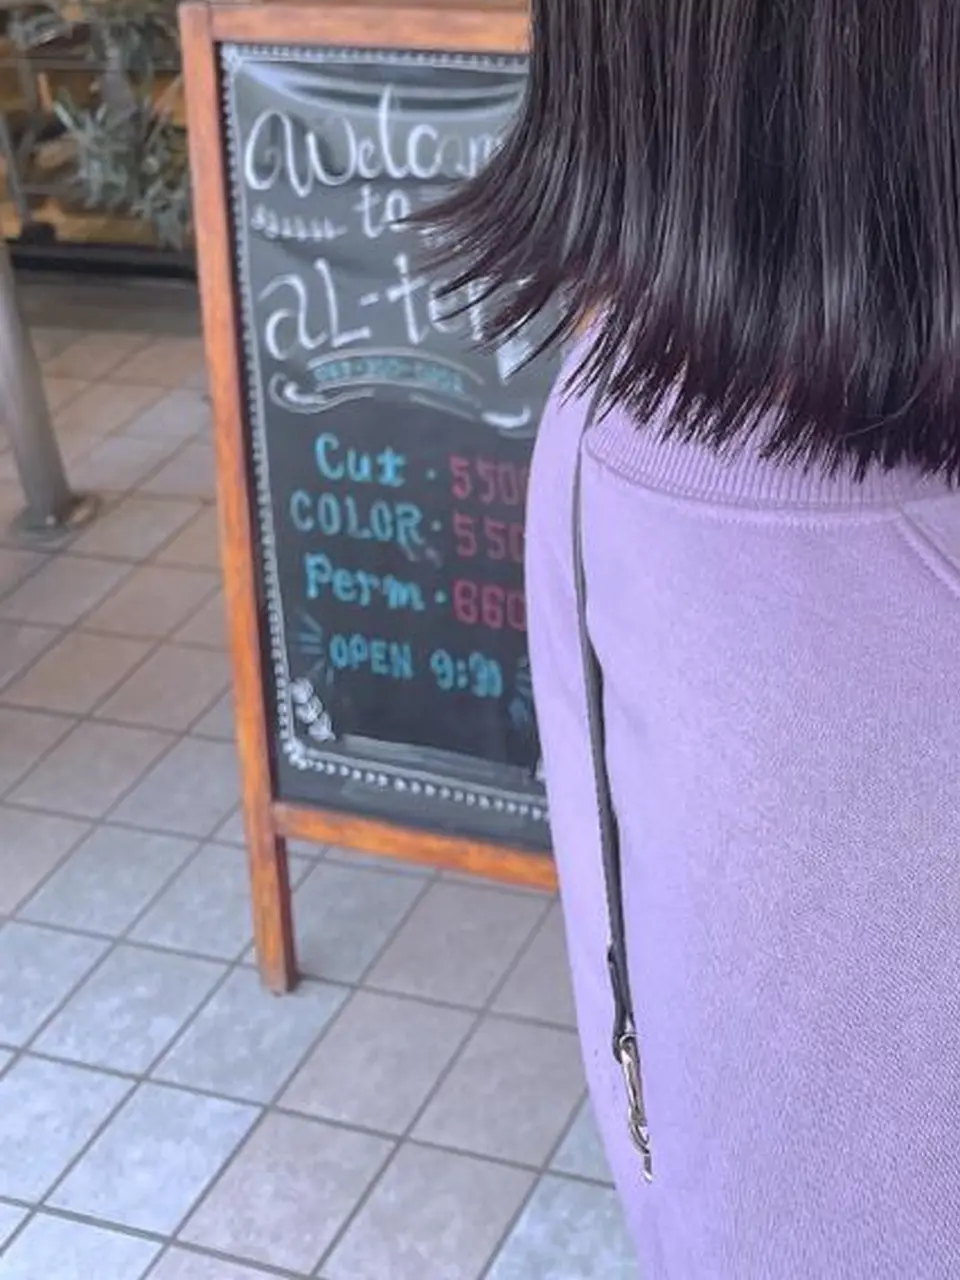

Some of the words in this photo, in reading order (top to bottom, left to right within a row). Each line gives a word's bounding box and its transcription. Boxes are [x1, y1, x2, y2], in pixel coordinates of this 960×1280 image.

[244, 83, 503, 198] Welcom
[353, 185, 411, 239] to
[314, 432, 407, 487] Cut
[289, 491, 425, 548] COLOR
[305, 552, 425, 611] Perm
[329, 633, 415, 681] OPEN
